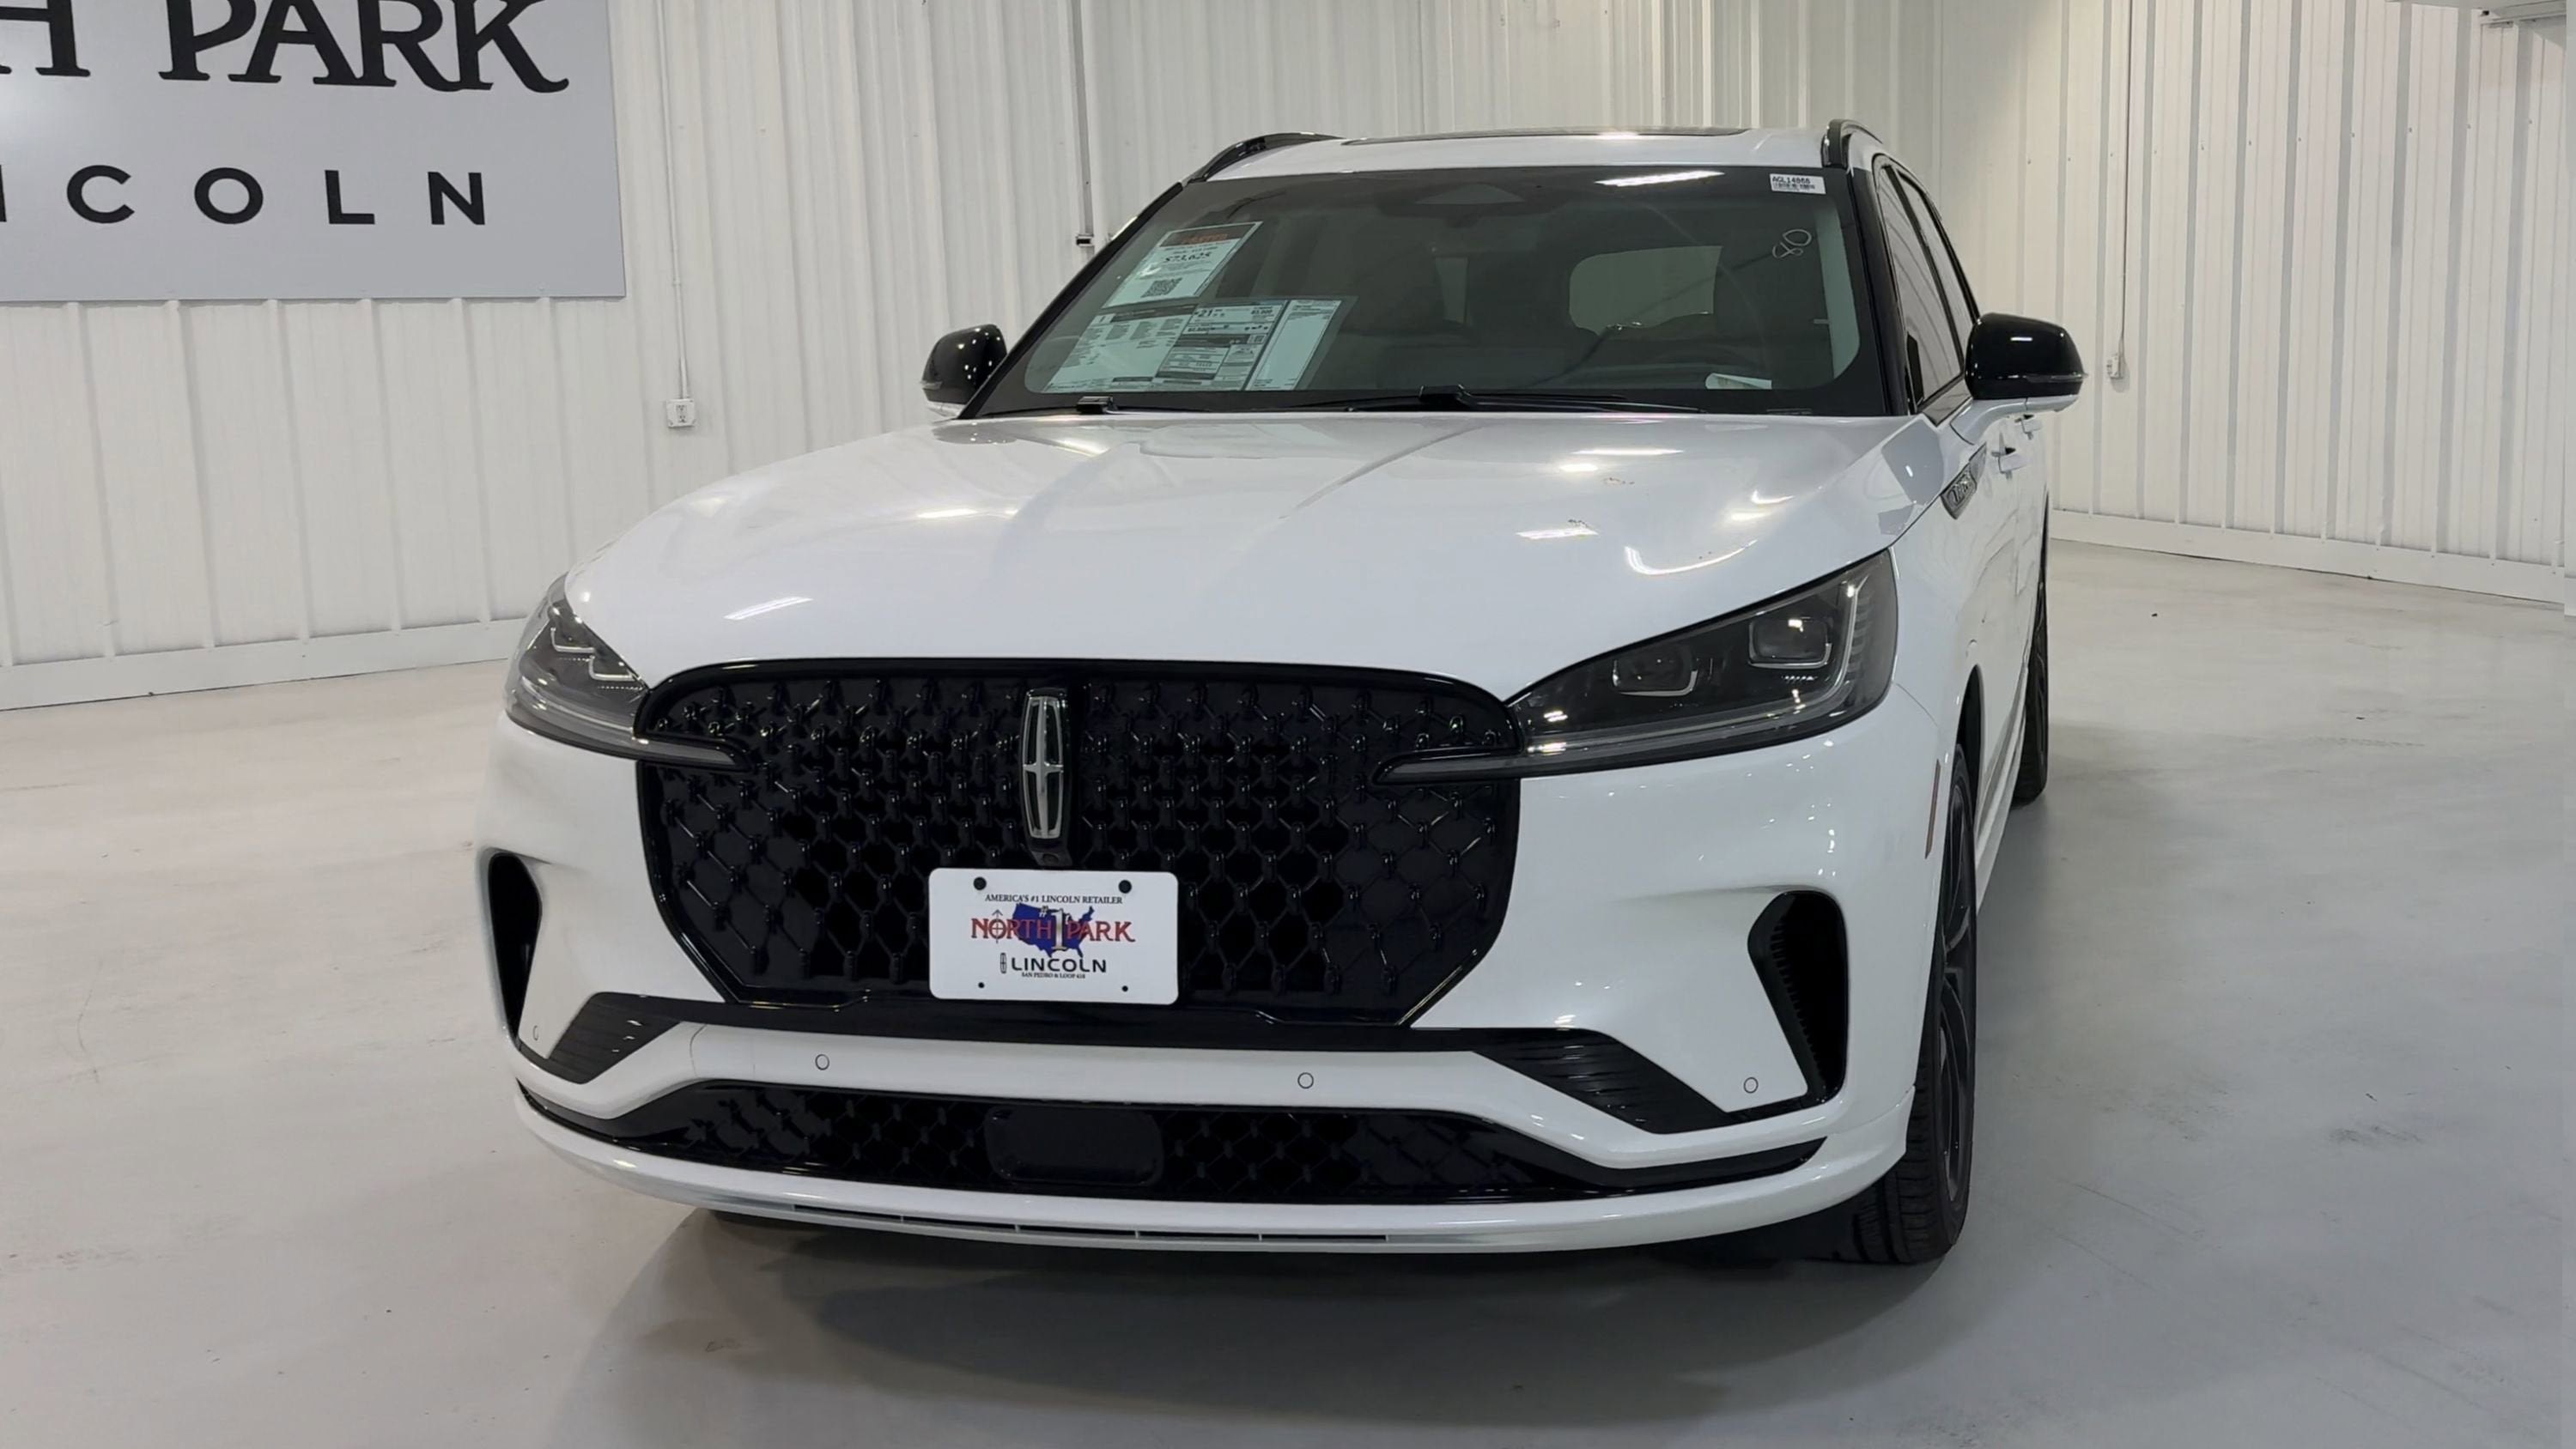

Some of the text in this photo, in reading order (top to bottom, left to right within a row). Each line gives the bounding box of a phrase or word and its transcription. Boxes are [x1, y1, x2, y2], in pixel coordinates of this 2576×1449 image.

[158, 0, 570, 93] PARK
[0, 165, 486, 225] COLN
[985, 894, 1030, 902] AMERICA'S
[1042, 895, 1080, 904] LINCOLN
[1082, 896, 1123, 905] RETAILER
[971, 917, 1136, 943] NORTH PARK
[1012, 957, 1106, 973] LINCOLN
